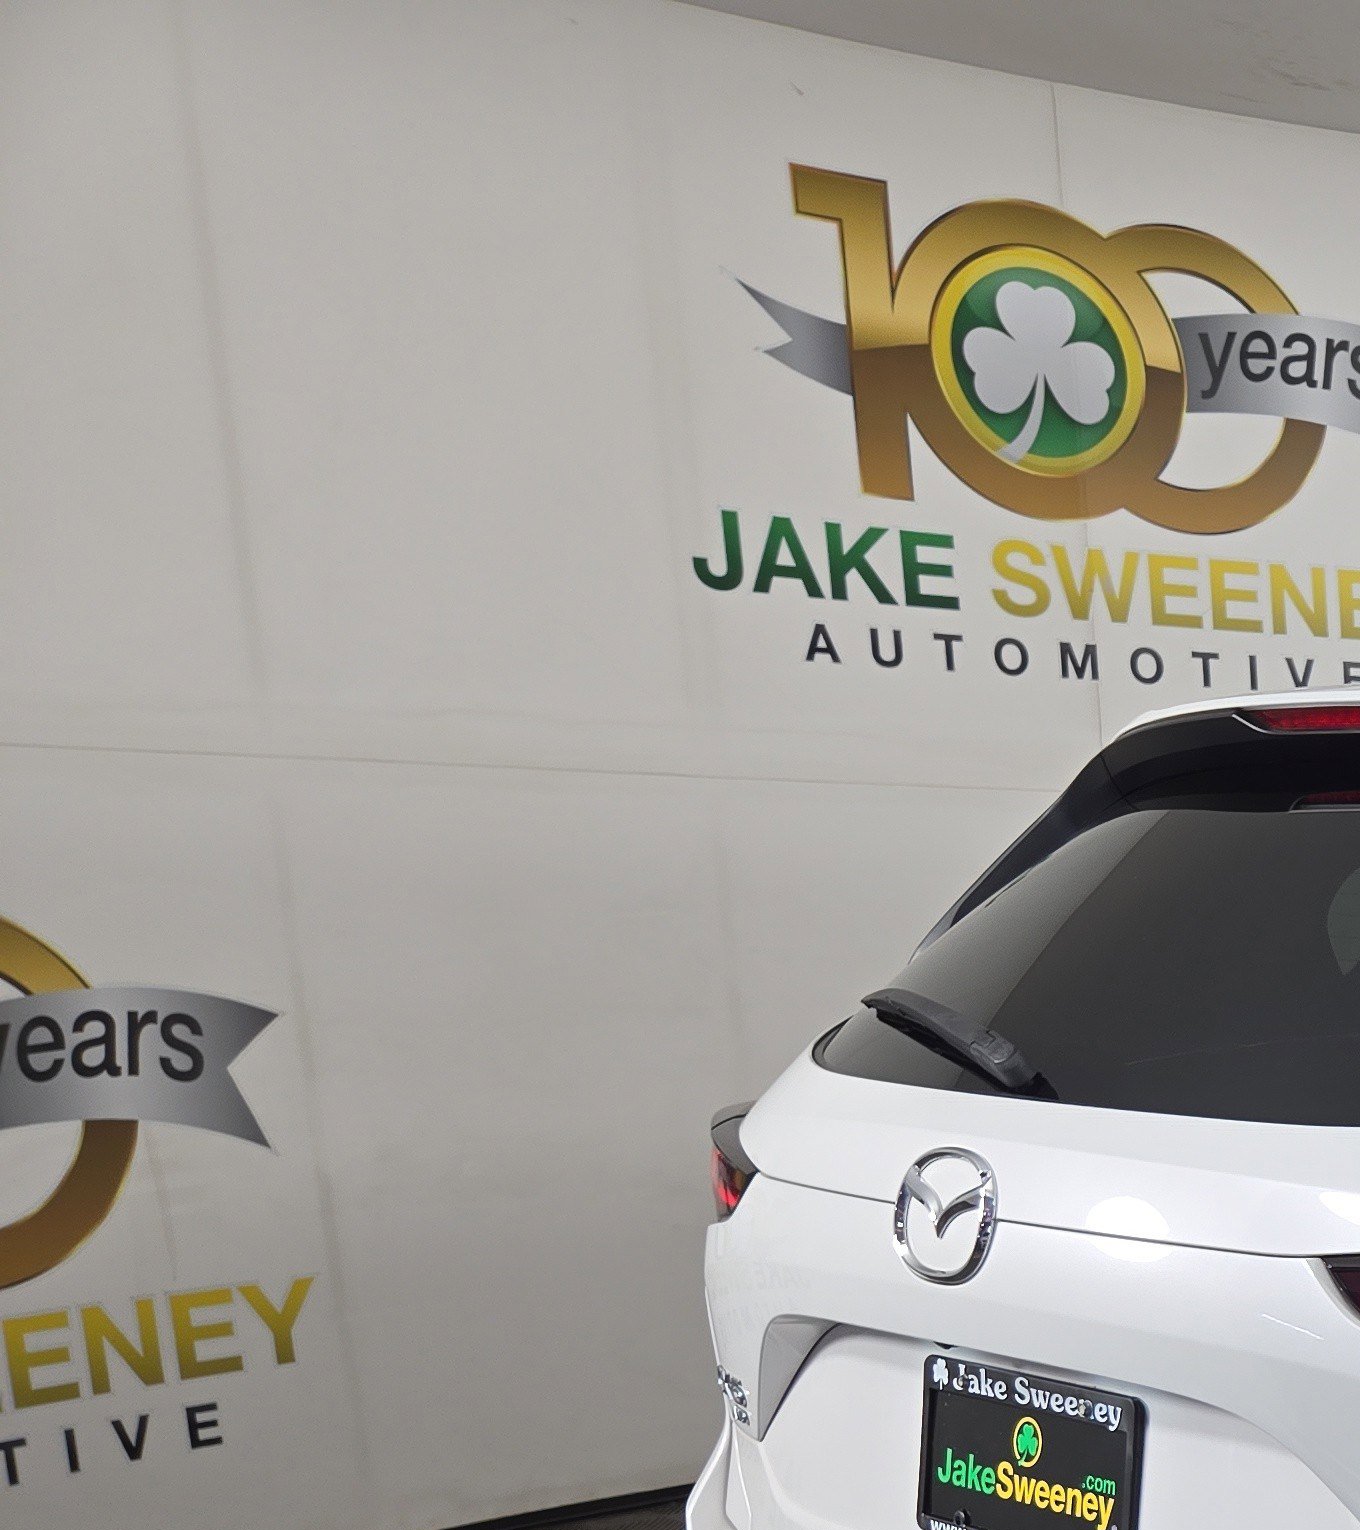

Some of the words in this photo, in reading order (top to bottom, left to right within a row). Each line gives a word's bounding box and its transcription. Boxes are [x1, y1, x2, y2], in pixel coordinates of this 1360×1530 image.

[691, 509, 962, 612] JAKE
[0, 1009, 205, 1083] ears
[0, 1275, 315, 1413] ENEY
[953, 1364, 1007, 1399] Jake
